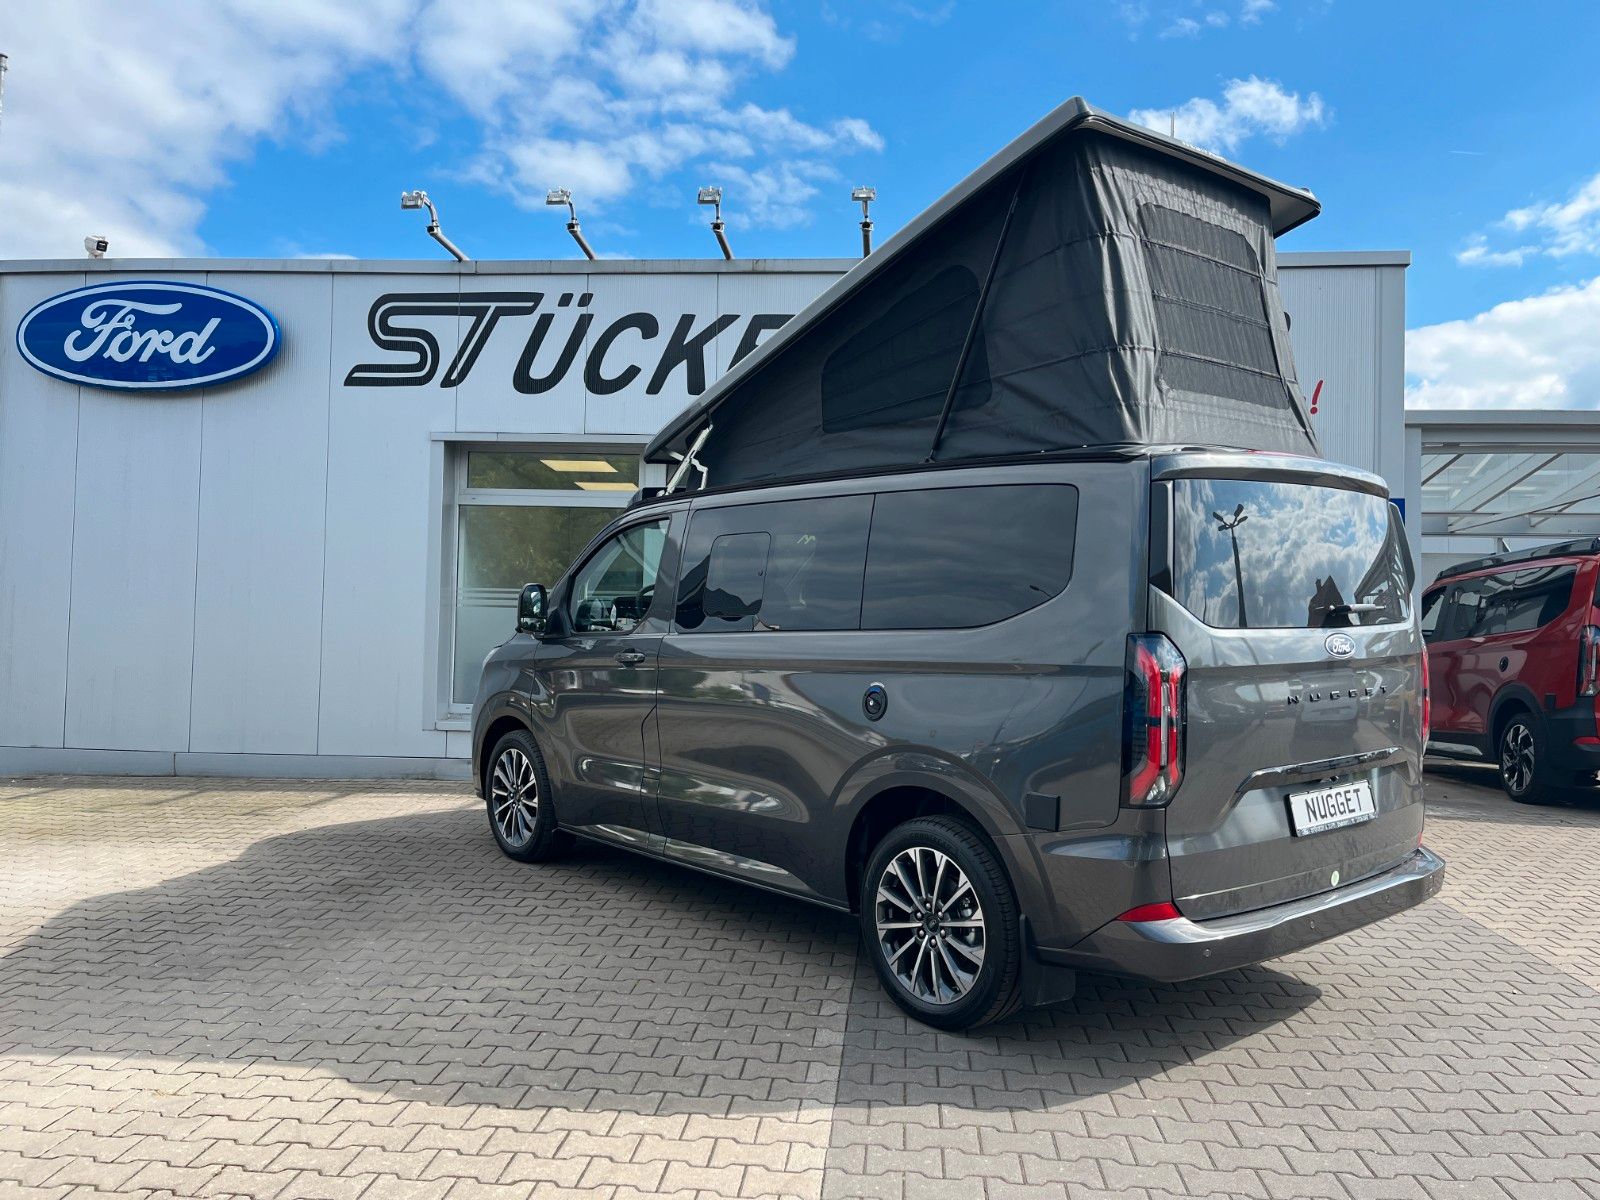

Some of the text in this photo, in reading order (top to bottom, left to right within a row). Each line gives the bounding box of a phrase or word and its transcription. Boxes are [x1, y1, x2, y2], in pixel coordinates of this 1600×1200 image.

[64, 299, 221, 363] Ford
[1332, 638, 1351, 653] Ford
[1287, 685, 1387, 705] NUGGET
[1305, 788, 1362, 823] NUGGET
